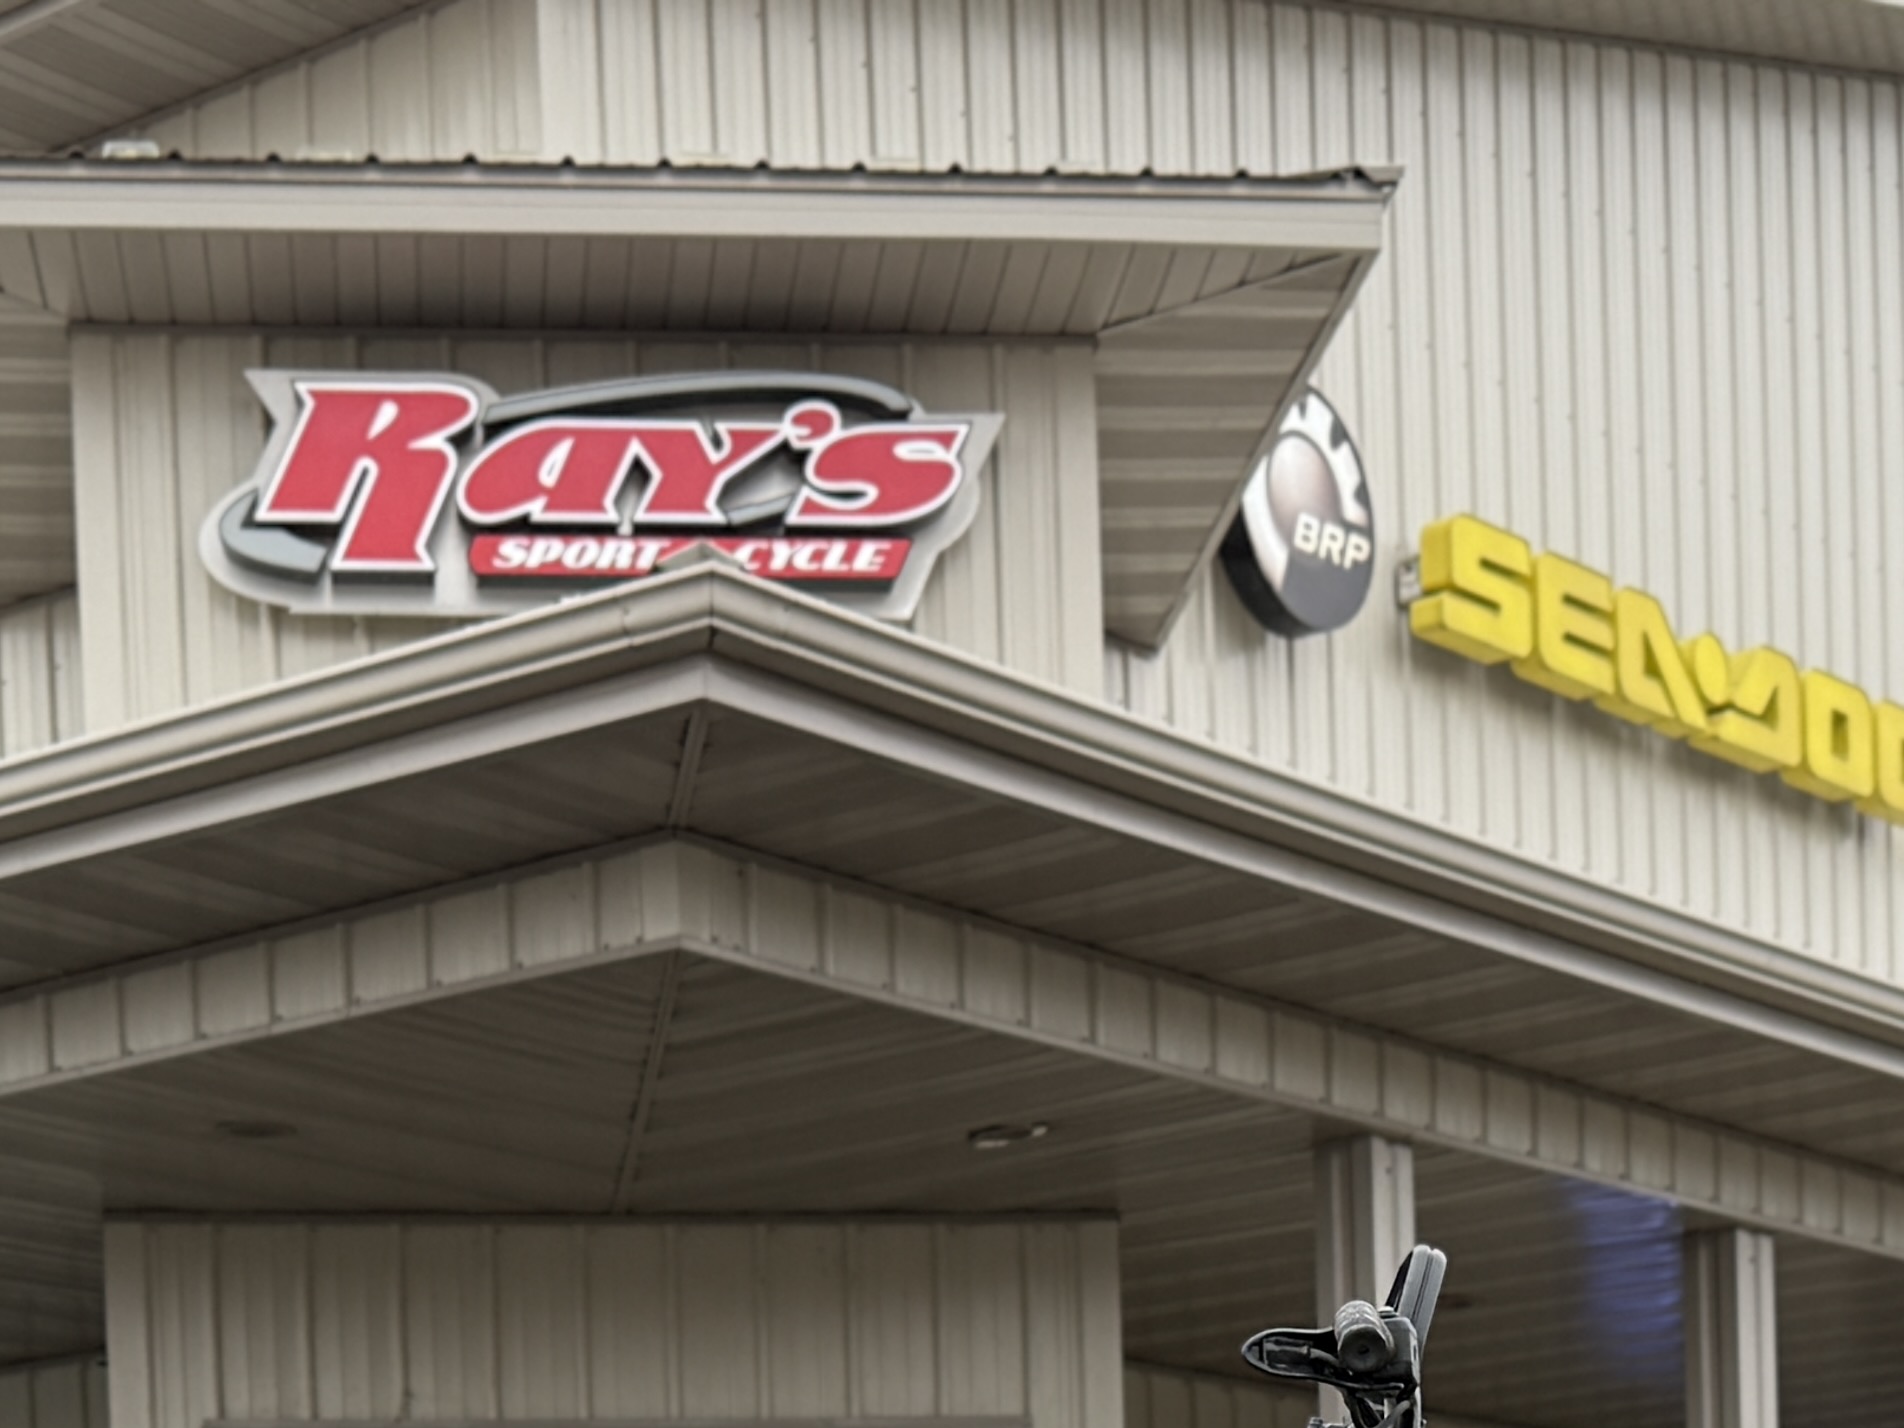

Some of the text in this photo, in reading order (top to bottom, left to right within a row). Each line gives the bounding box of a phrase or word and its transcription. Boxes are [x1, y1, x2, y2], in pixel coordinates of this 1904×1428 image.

[493, 538, 893, 572] SPORT CYCLE
[1293, 512, 1372, 571] BRP
